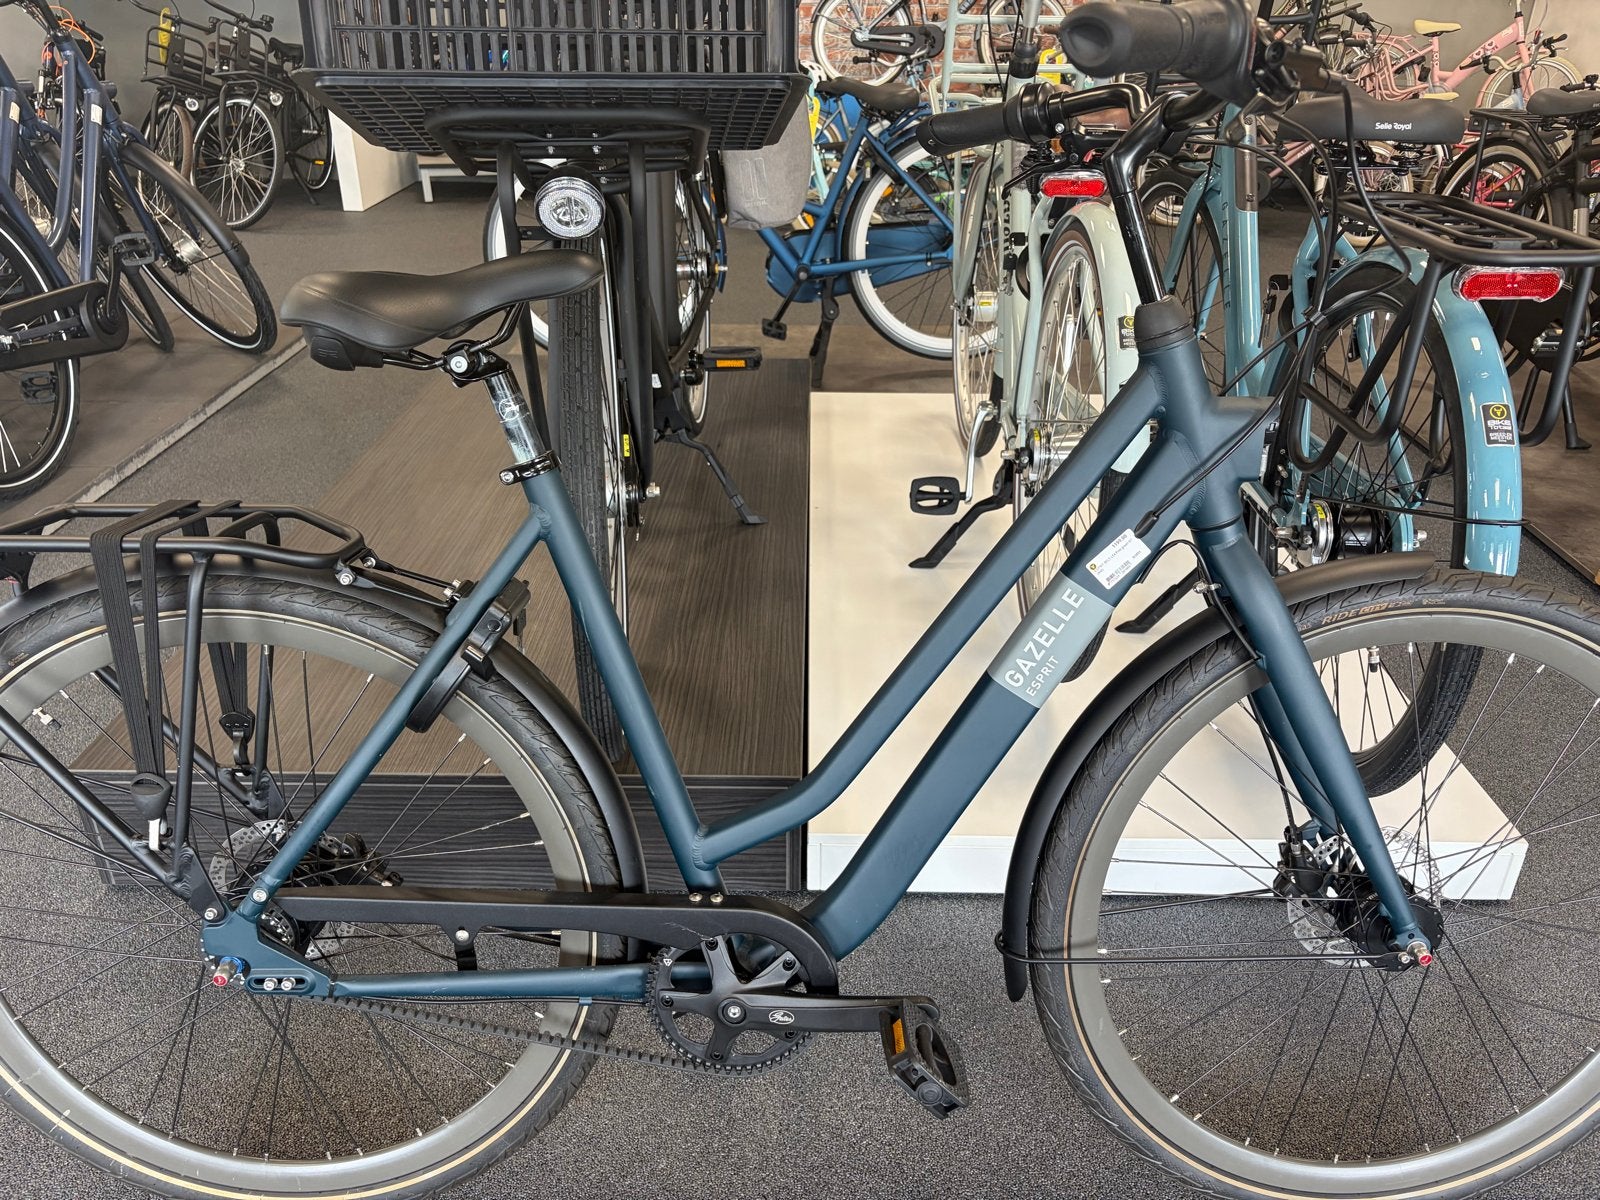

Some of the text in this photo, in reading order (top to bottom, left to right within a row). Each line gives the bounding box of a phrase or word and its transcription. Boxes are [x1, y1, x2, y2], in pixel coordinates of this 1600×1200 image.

[1375, 122, 1412, 131] Selle Royal
[1321, 608, 1360, 625] RIDE
[1004, 587, 1085, 688] GAZELLE
[1025, 655, 1059, 697] ESPRIT
